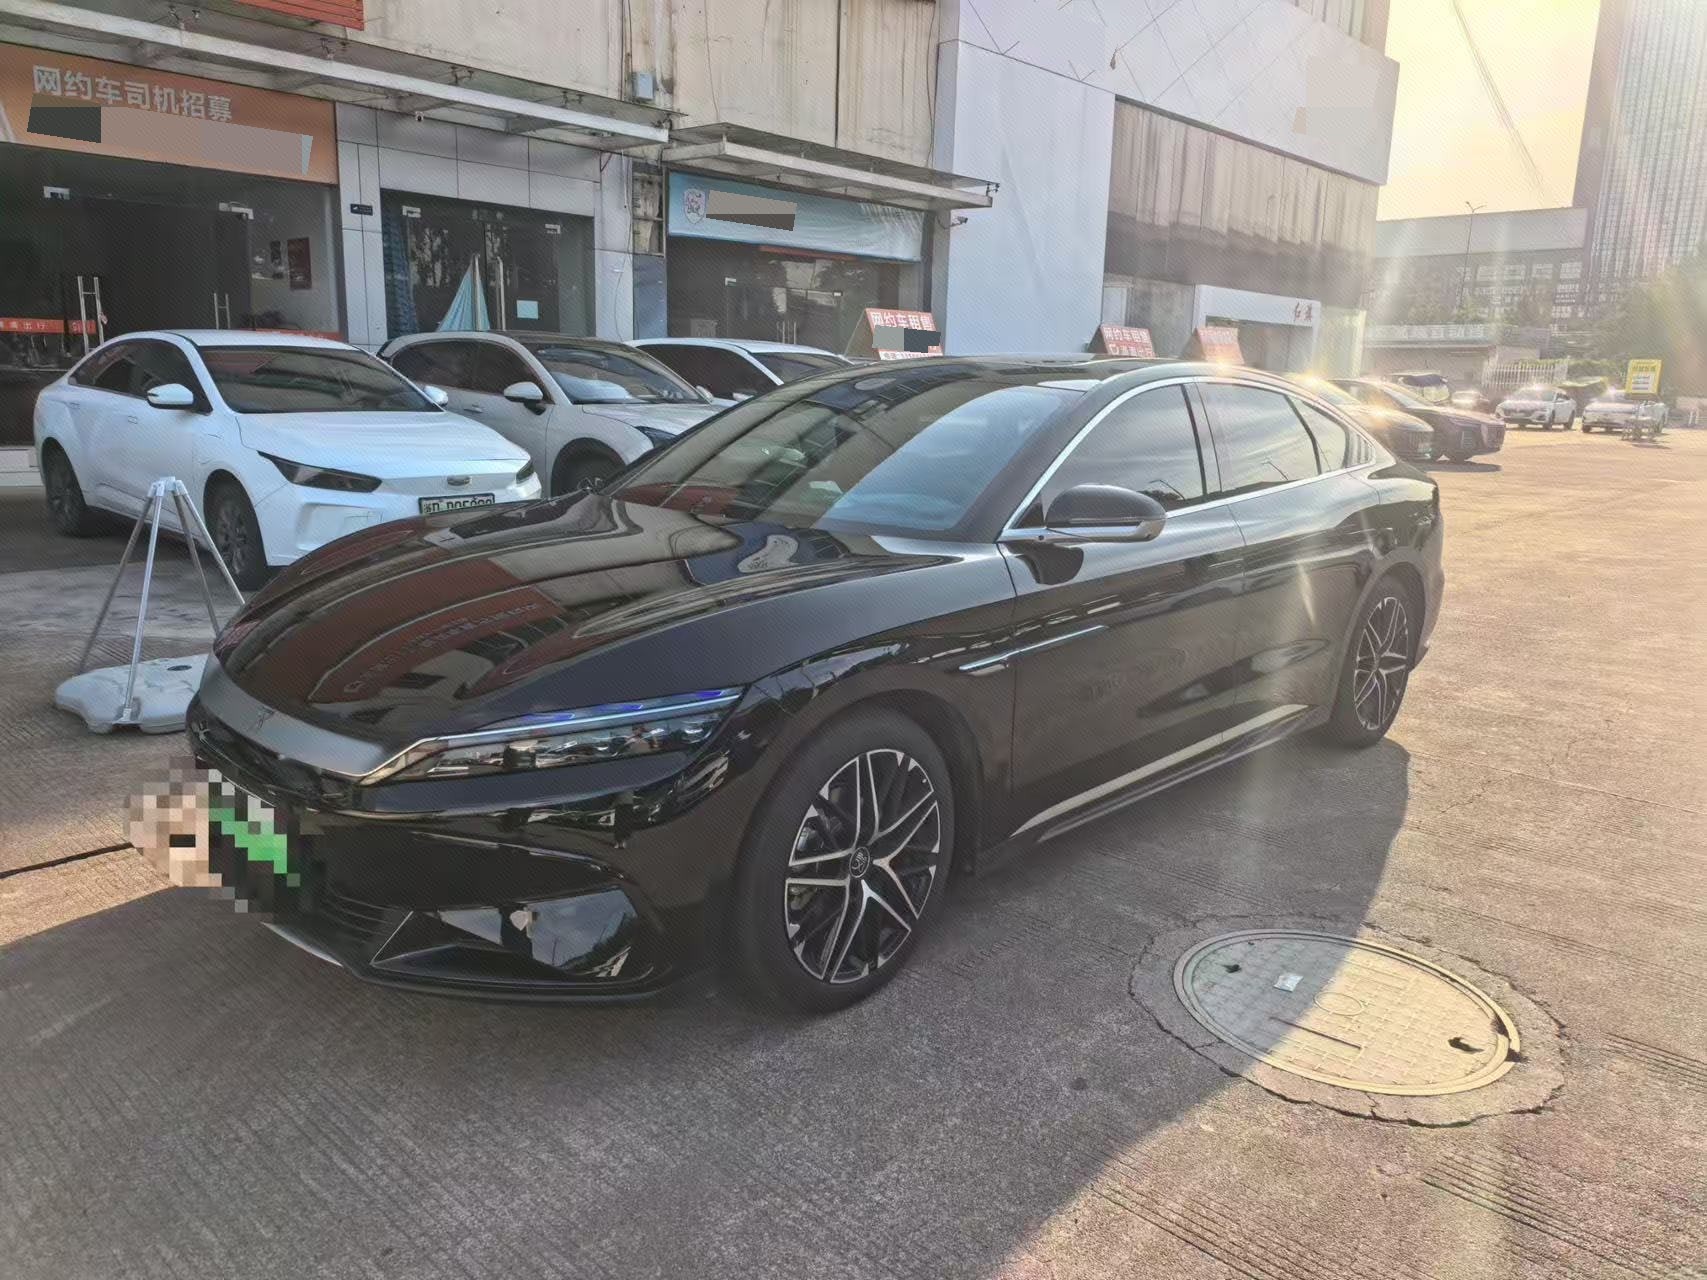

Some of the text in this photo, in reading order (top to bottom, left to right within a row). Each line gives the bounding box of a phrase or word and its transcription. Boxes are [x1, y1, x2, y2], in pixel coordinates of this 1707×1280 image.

[33, 65, 233, 122] 网约车司机招募
